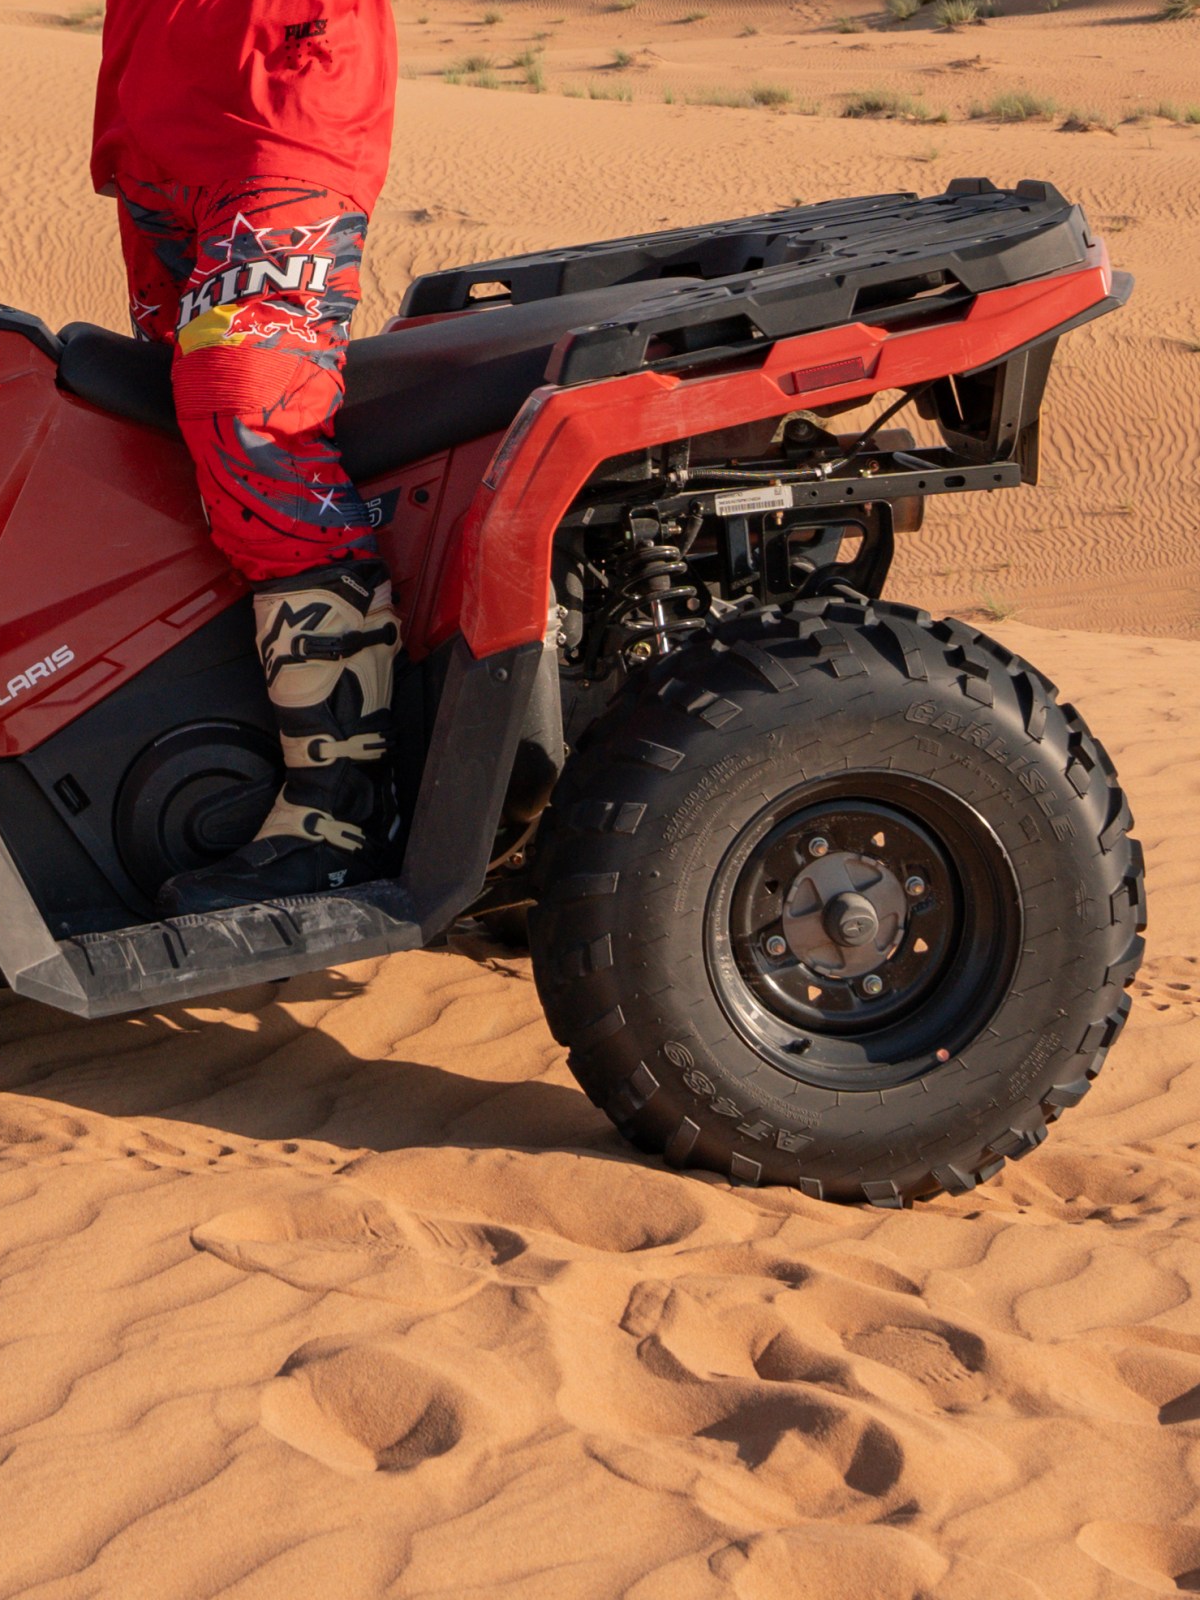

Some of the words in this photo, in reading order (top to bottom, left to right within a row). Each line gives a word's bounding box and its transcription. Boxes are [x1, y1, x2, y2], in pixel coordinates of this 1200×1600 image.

[176, 256, 334, 331] KINI
[905, 701, 1076, 842] CARLISLE
[663, 1040, 815, 1154] AT489
